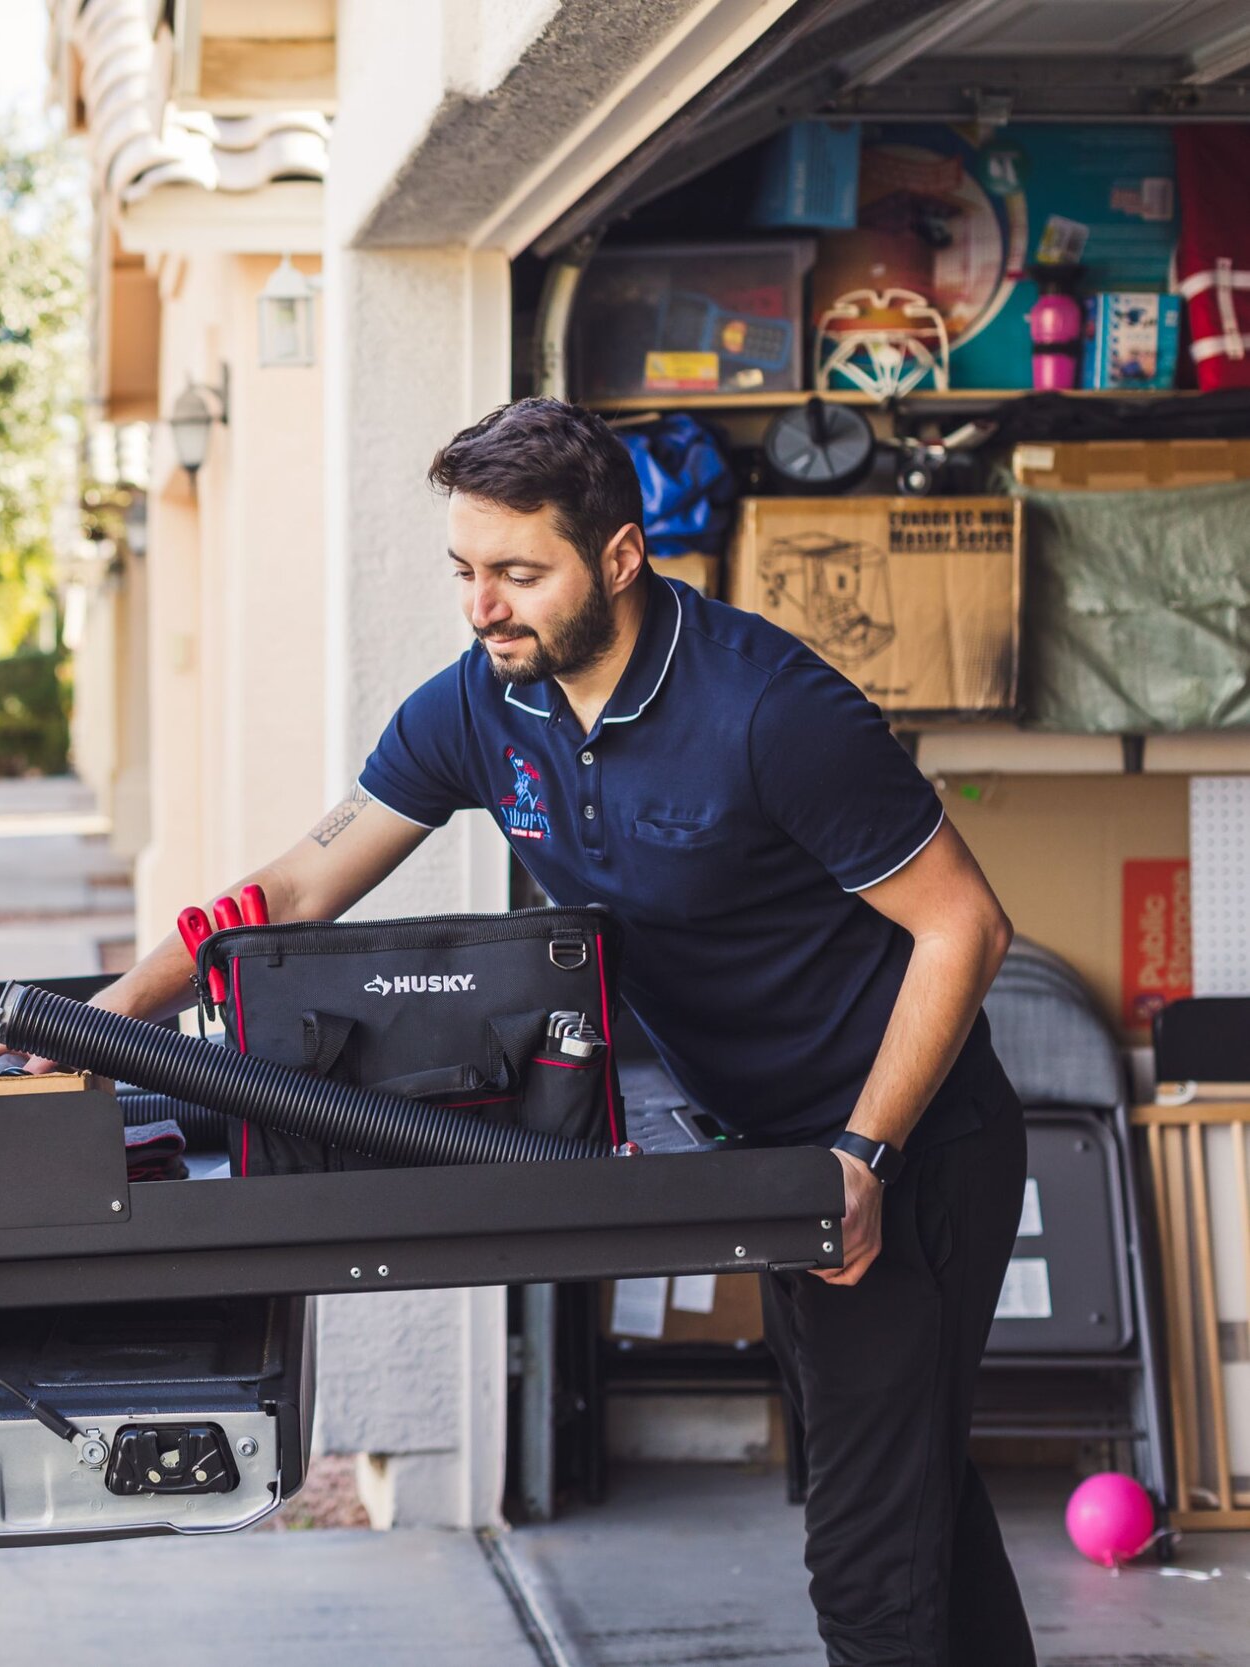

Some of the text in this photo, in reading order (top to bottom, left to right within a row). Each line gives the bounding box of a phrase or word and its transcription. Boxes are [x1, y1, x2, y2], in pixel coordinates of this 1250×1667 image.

[890, 531, 1014, 547] Master Series
[501, 806, 550, 833] Liberty
[1138, 894, 1167, 988] Public
